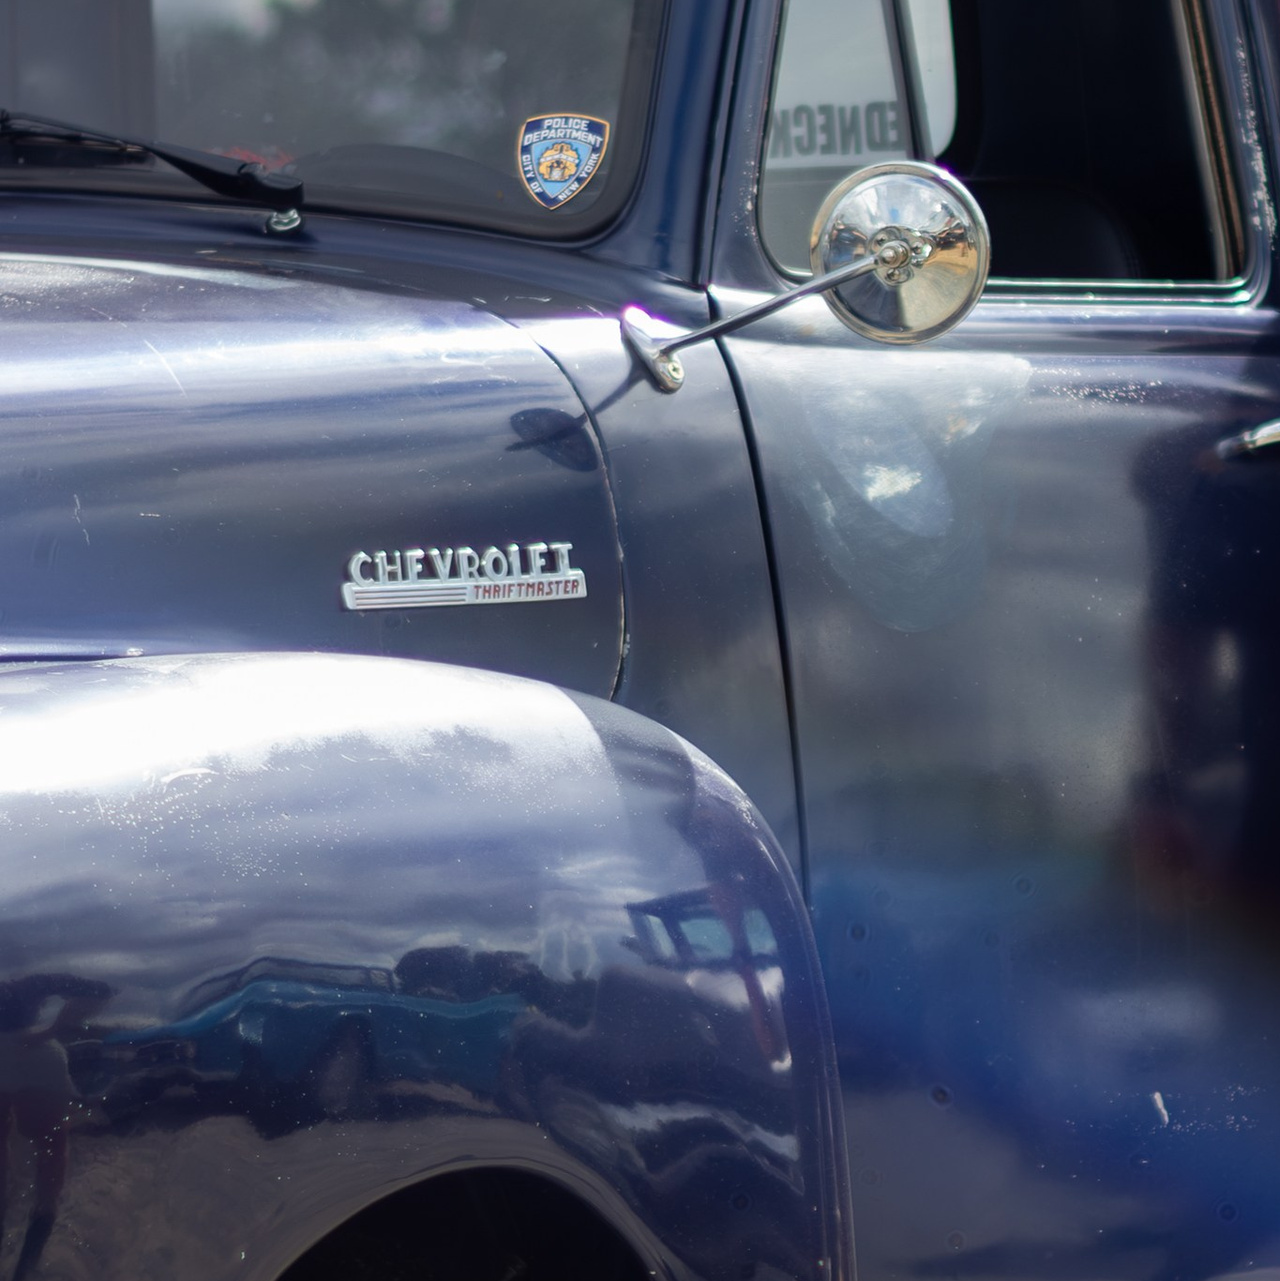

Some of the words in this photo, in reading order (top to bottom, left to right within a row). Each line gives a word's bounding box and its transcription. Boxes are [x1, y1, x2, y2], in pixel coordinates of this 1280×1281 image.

[544, 118, 589, 130] POLICE
[524, 129, 603, 147] DEPARTMENT
[522, 154, 535, 179] CITY
[530, 181, 543, 194] OF
[558, 181, 580, 201] NEW
[580, 153, 600, 179] YORK
[349, 541, 573, 587] CHEVROLET
[473, 578, 580, 601] THRIFTMASTER
